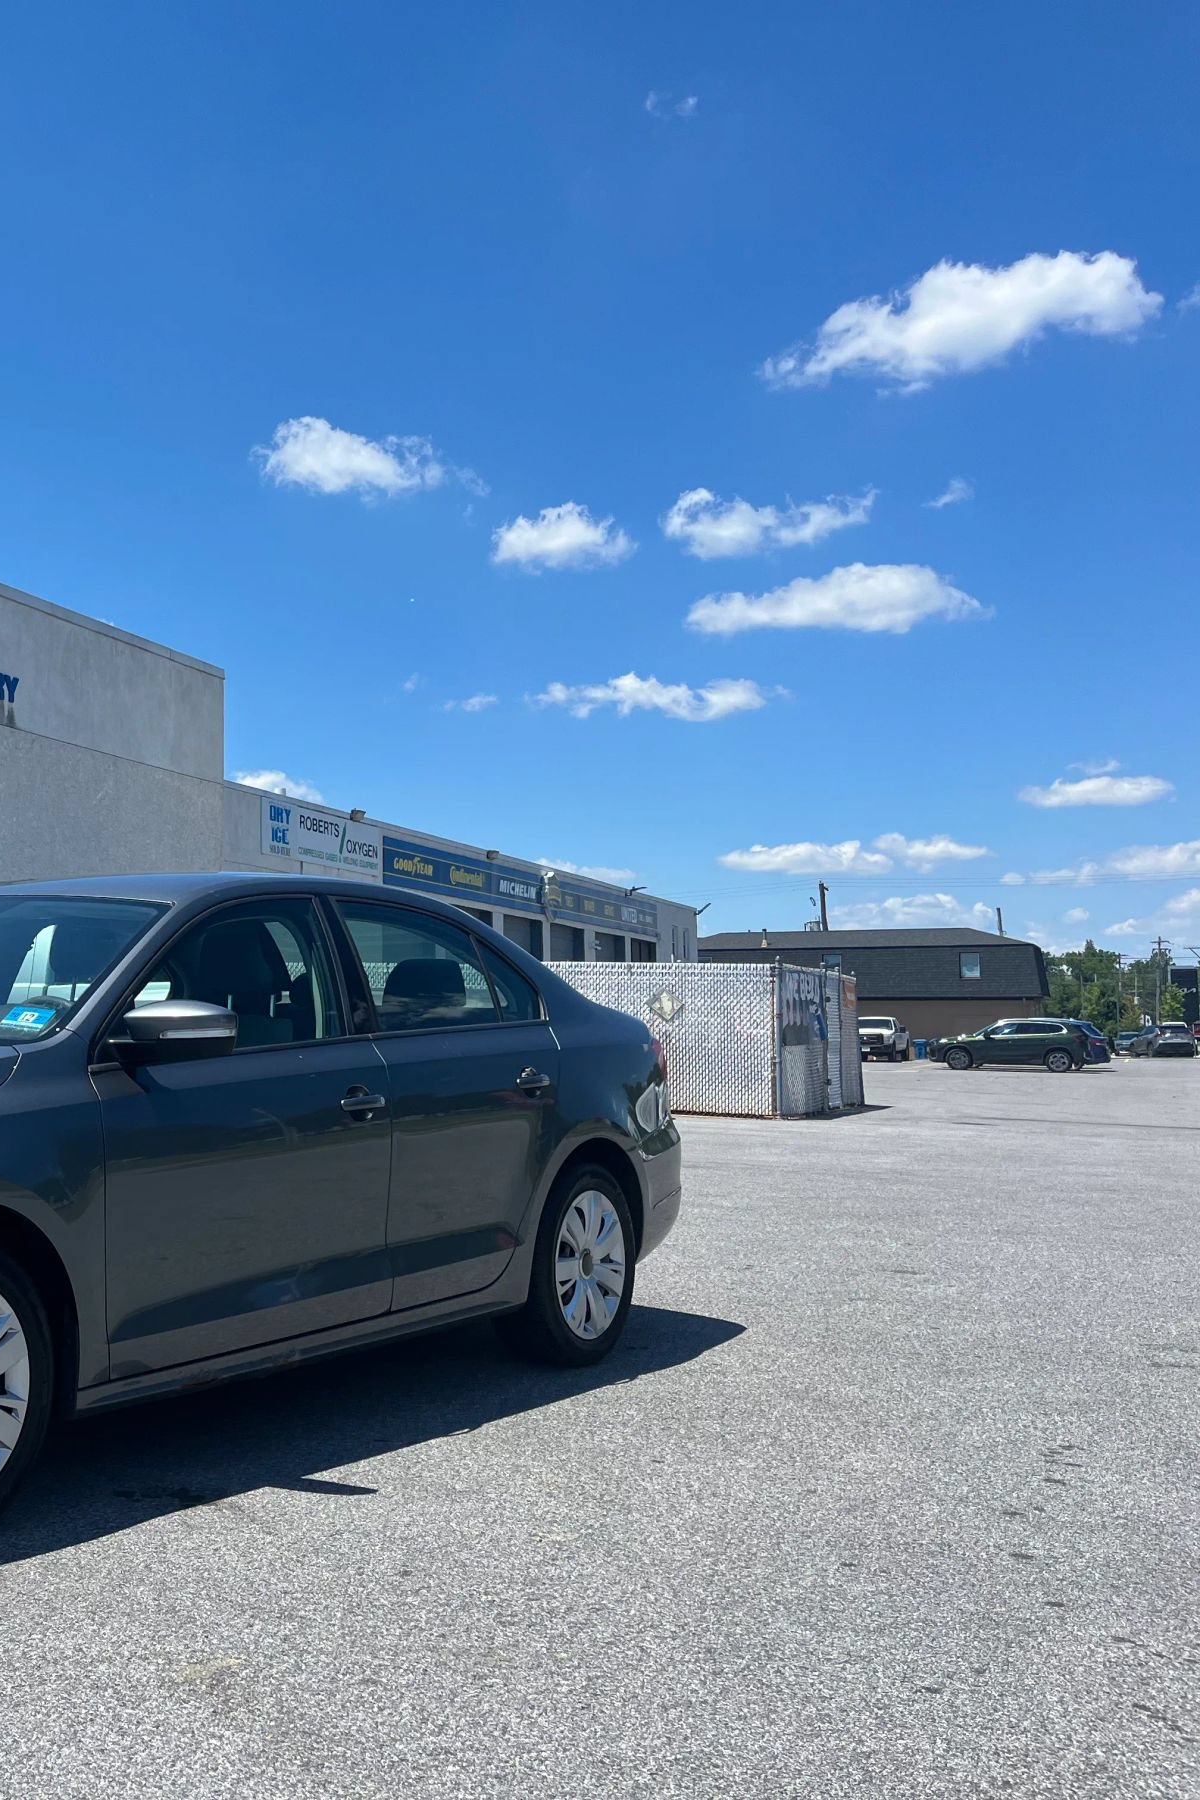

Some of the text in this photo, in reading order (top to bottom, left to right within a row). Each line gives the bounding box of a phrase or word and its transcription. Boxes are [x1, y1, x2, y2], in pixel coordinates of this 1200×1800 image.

[269, 804, 291, 824] DRY
[271, 827, 289, 845] ICE
[299, 814, 339, 838] ROBERTS
[346, 839, 378, 859] OXYGEN
[393, 856, 433, 877] GOODYEAR
[450, 866, 483, 887] Continental
[500, 880, 536, 899] MICHELIN
